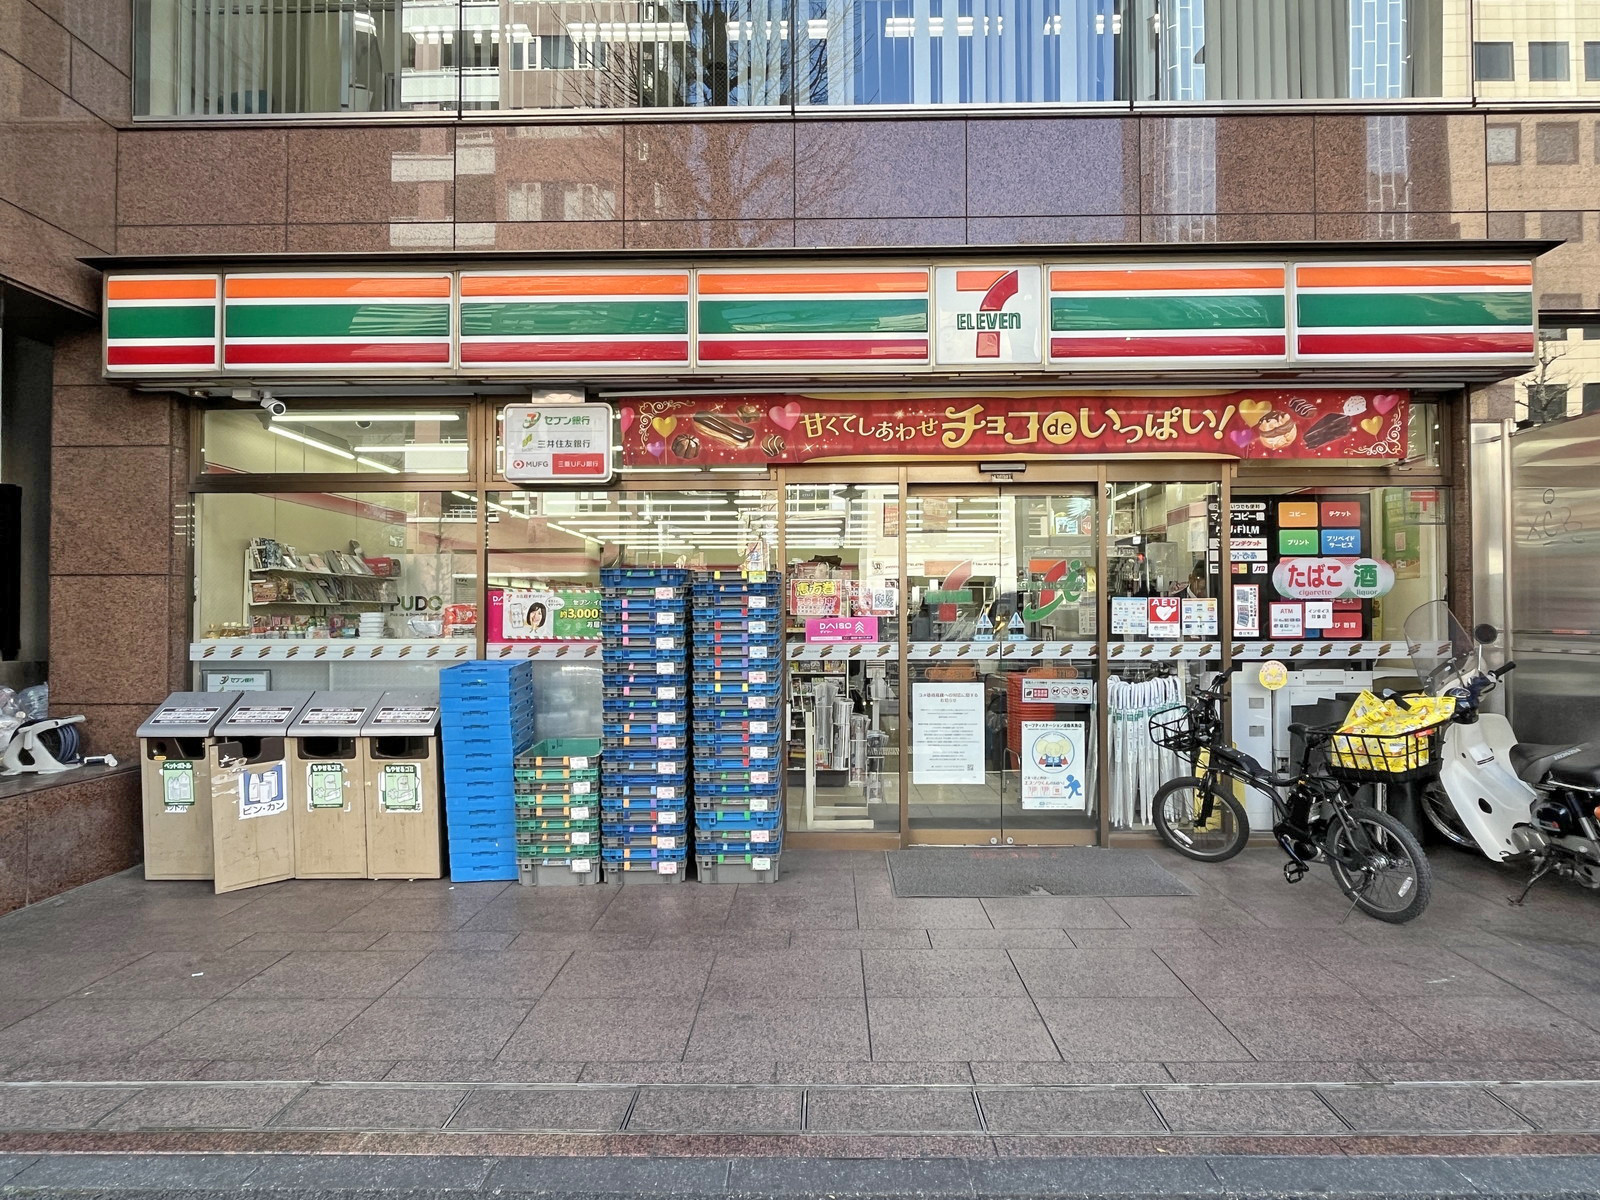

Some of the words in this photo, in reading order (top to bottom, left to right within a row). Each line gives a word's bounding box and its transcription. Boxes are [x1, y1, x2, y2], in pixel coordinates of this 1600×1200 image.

[544, 415, 590, 426] セブン銀行
[803, 410, 938, 443] 甘くてしあわせ
[537, 439, 591, 449] 三井住友銀行
[525, 460, 549, 468] MUFG
[558, 460, 599, 468] 三菱UFJ銀行
[1329, 510, 1352, 518] チケット
[1287, 563, 1343, 589] たばこ
[1353, 563, 1379, 589] 酒
[796, 580, 836, 597] 恵方巻
[1298, 589, 1333, 597] cigarette
[1356, 589, 1379, 597] liquor
[1151, 598, 1178, 607] AED
[819, 622, 852, 630] DAISO
[1553, 747, 1582, 760] HONDA
[163, 762, 193, 770] ペットボトル
[312, 764, 342, 773] もやせるゴミ
[385, 765, 415, 773] もやせるゴミ
[242, 802, 285, 816] ビン・カン
